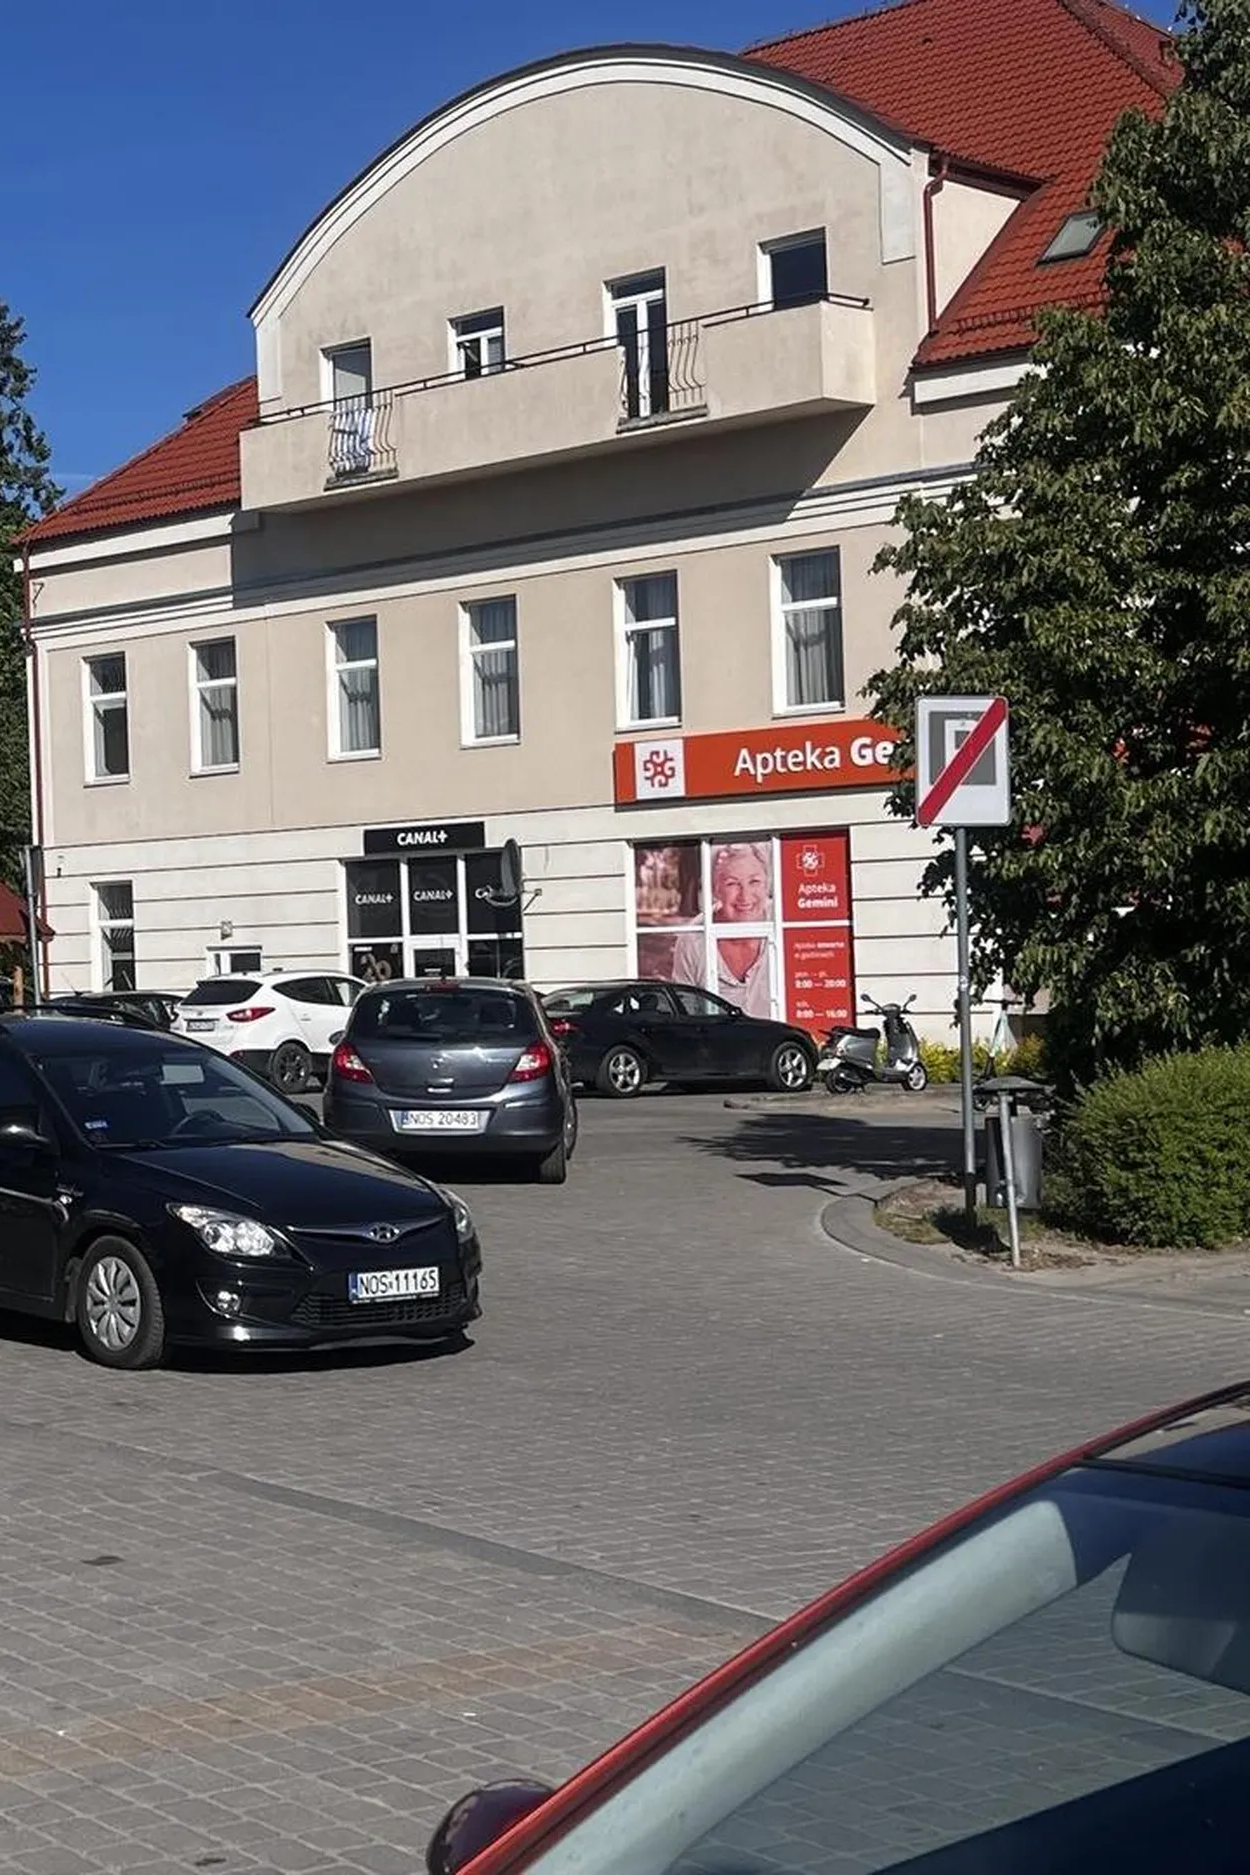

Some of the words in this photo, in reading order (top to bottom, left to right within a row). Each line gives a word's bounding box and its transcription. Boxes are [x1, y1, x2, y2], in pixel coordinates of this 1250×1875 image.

[734, 741, 840, 783] Apteka
[850, 736, 895, 767] Ge
[397, 830, 448, 846] CANAL+
[413, 889, 453, 901] CANAL+
[799, 882, 837, 896] Apteka
[355, 893, 393, 905] CANAL+
[797, 896, 839, 908] Gemini
[409, 1112, 434, 1125] NOS
[438, 1111, 477, 1125] 20483
[359, 1273, 388, 1295] NOS
[395, 1269, 437, 1292] 11165
